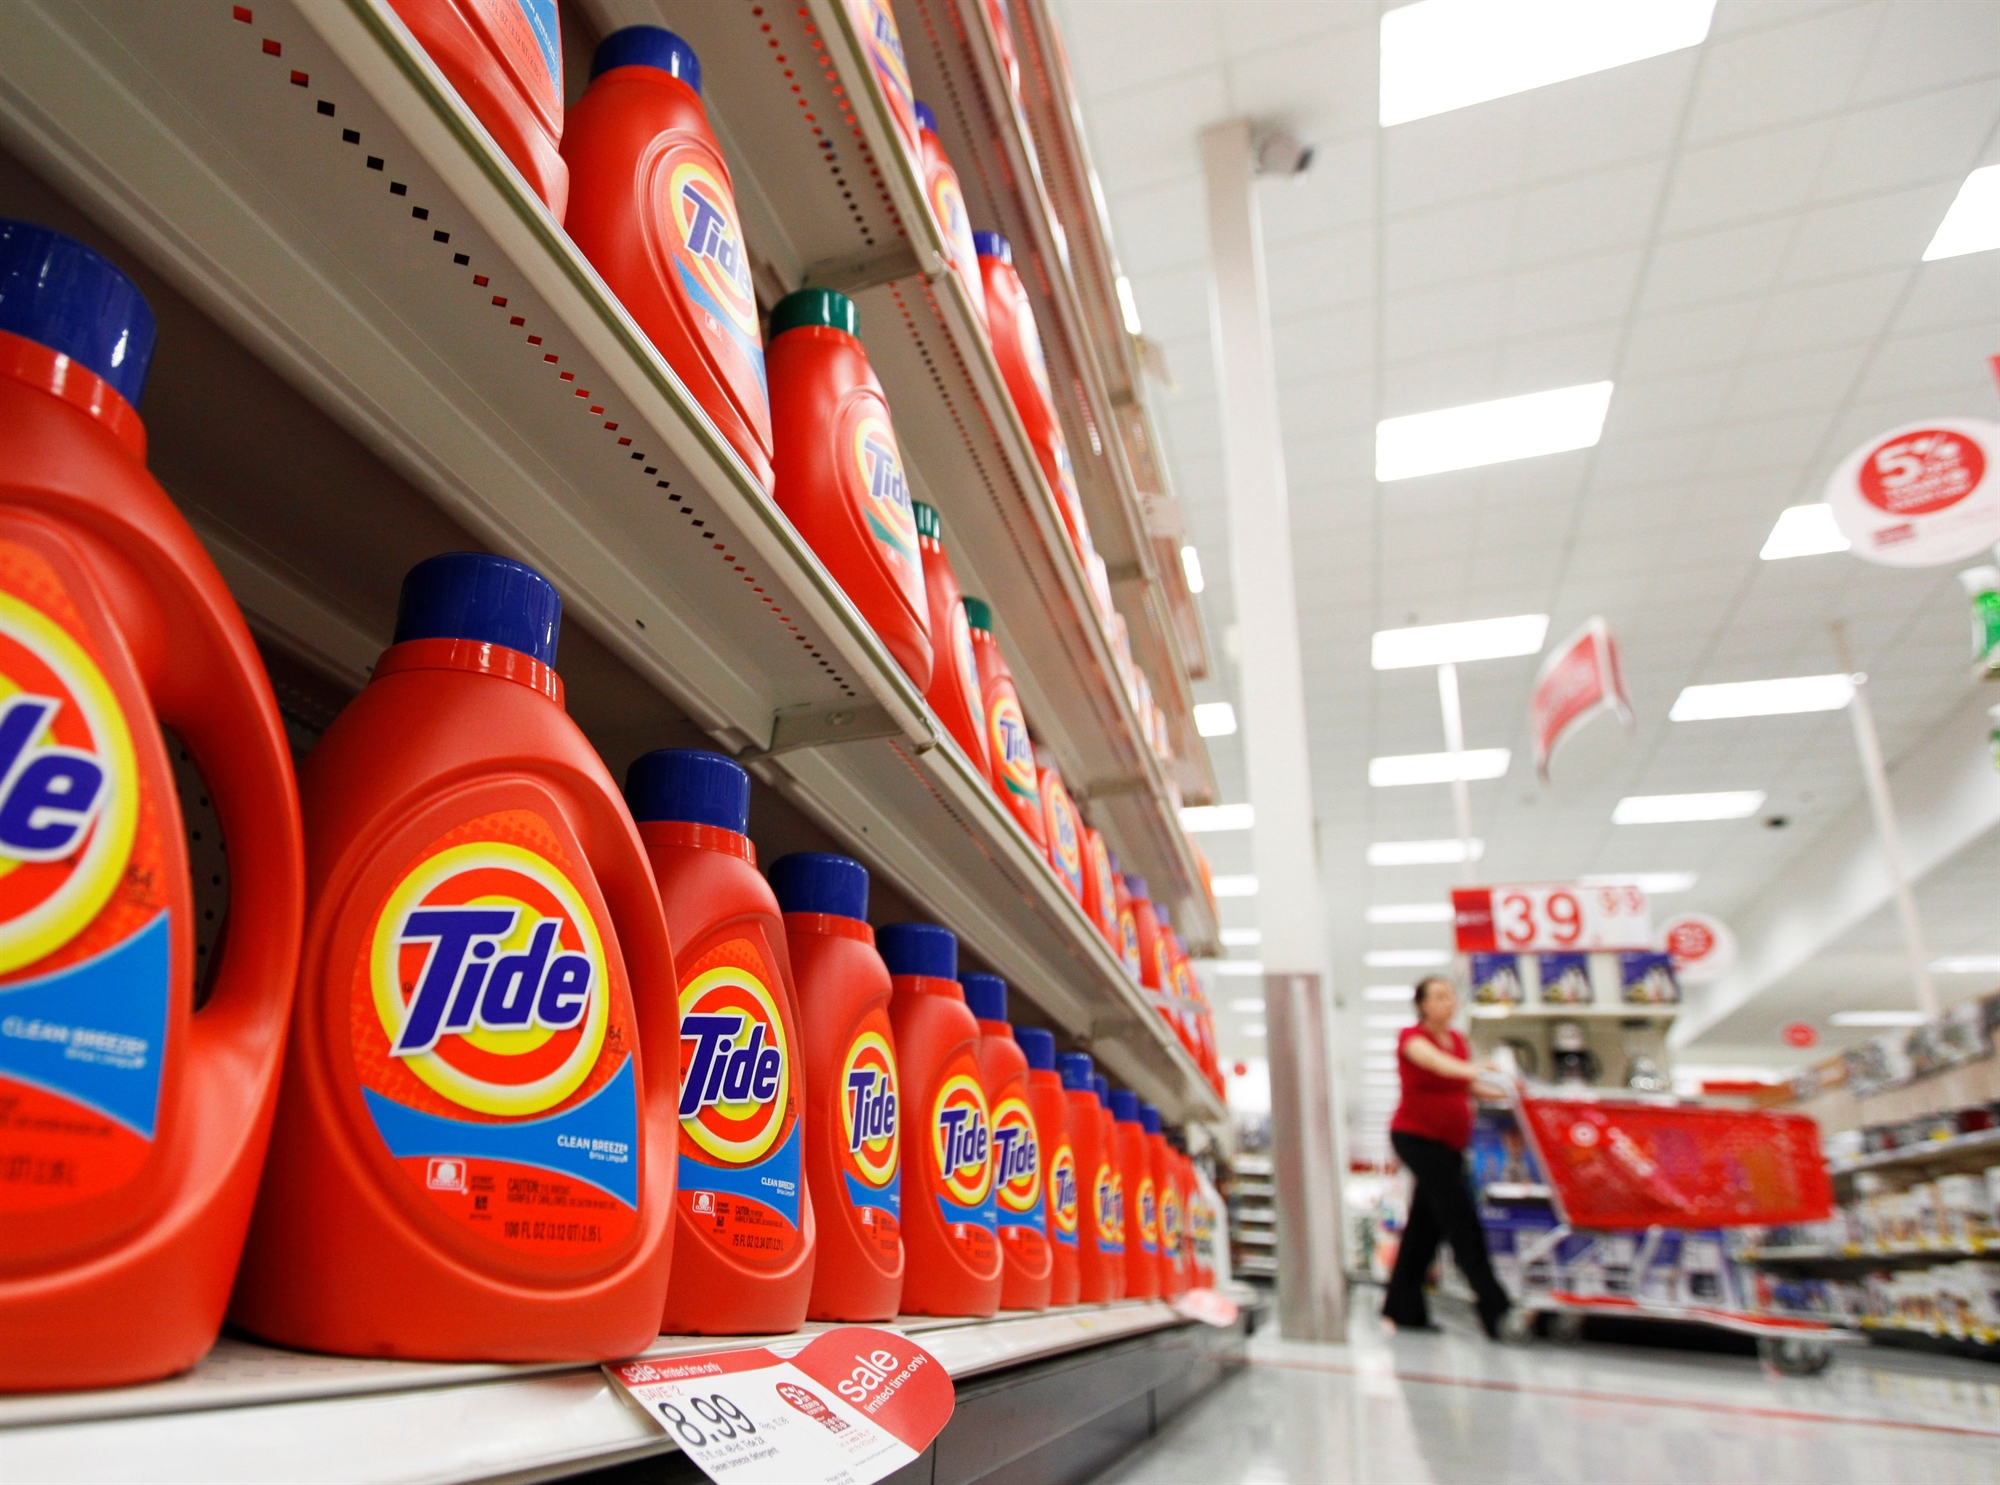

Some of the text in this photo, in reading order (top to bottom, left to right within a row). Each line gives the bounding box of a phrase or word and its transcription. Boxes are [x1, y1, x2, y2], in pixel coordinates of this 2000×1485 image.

[683, 183, 752, 303] Tide
[1874, 433, 1961, 488] 5%
[1503, 892, 1583, 946] 39
[389, 906, 592, 1056] Tide
[609, 1025, 621, 1041] 64
[679, 1014, 782, 1119] Tide
[848, 1070, 896, 1153] Tide
[557, 1134, 590, 1150] CLEAN
[940, 1108, 988, 1179] Tide
[994, 1127, 1037, 1189] Tide
[761, 1177, 777, 1187] CLEAN
[621, 1362, 723, 1383] sale limited time only
[639, 1386, 673, 1401] SAVE
[779, 1385, 806, 1405] 5%
[837, 1350, 899, 1403] sale
[863, 1353, 928, 1414] limited time only
[658, 1394, 757, 1448] 8.99
[741, 1440, 756, 1449] Tide
[710, 1446, 780, 1473] clean breeze detergent
